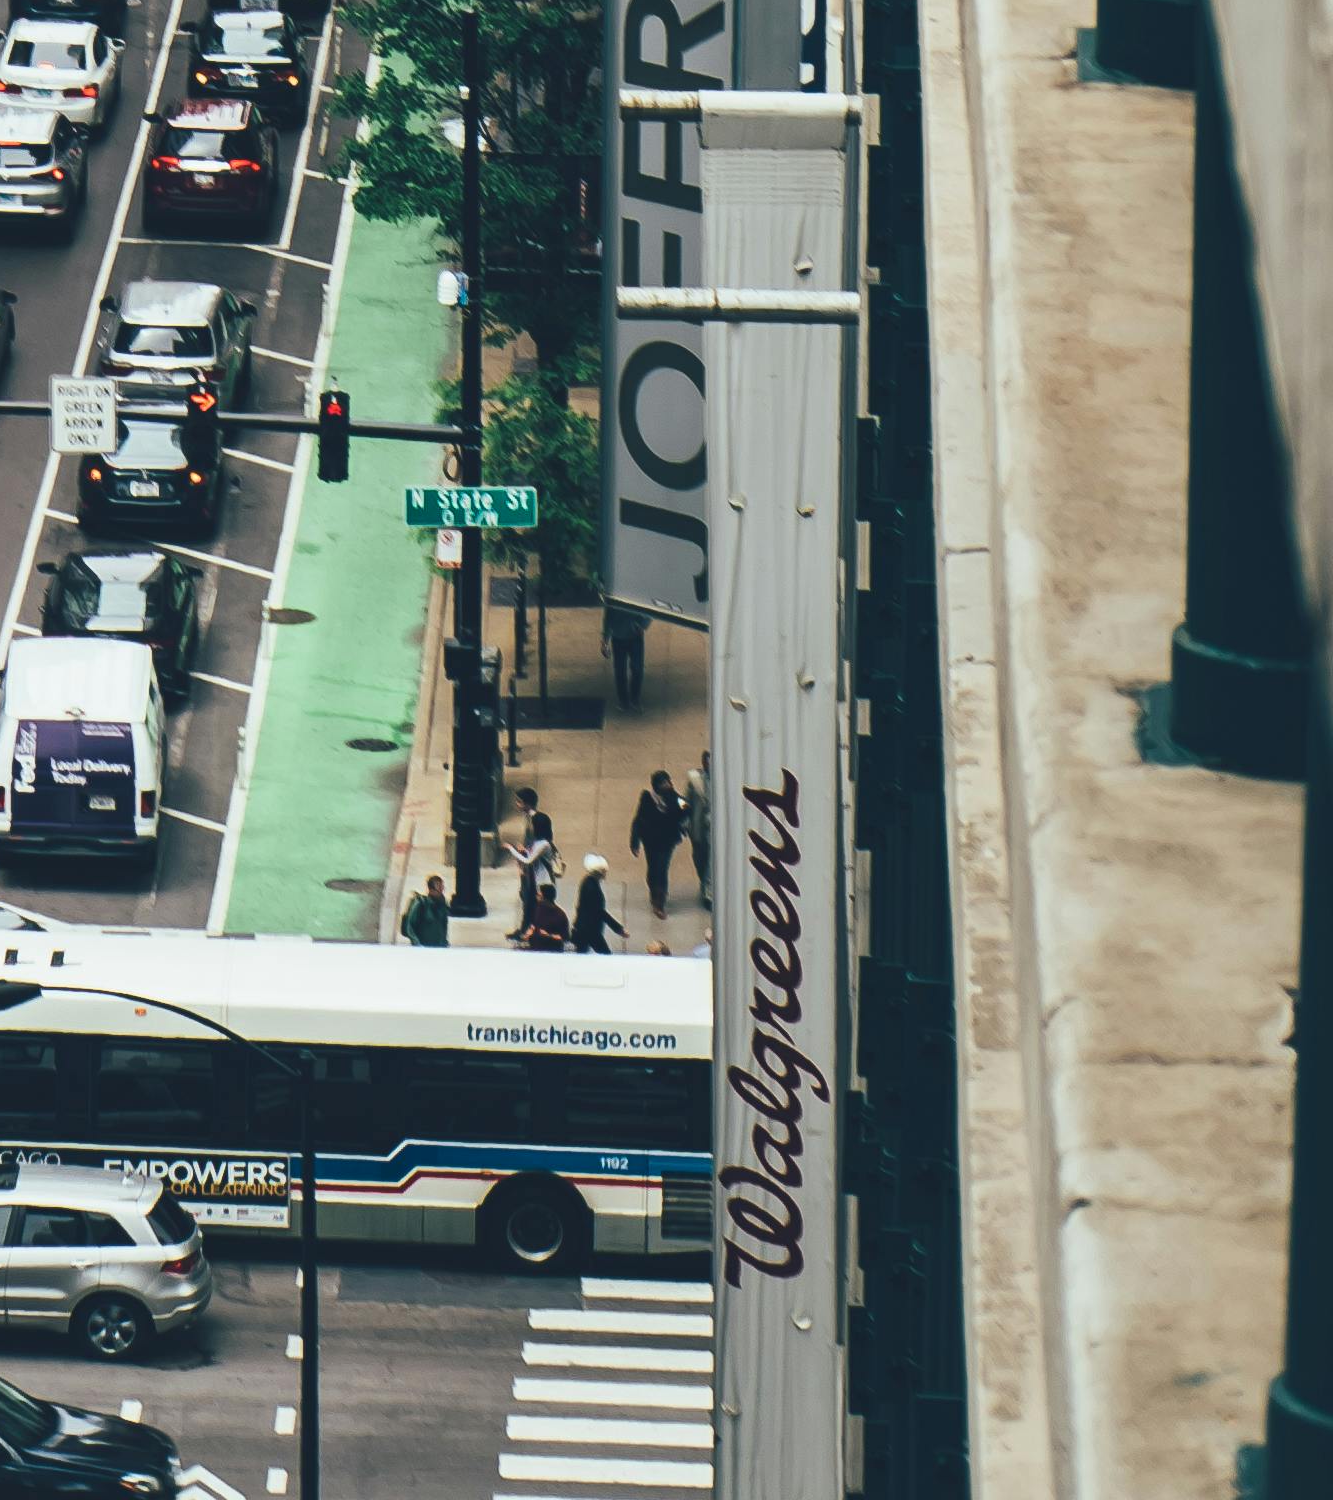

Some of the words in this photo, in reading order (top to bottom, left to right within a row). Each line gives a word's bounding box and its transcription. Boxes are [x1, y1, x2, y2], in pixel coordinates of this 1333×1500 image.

[411, 488, 425, 509] N
[438, 489, 494, 511] State
[506, 488, 529, 511] St
[467, 1022, 677, 1050] transitchicago.com
[723, 767, 831, 1290] Walgreens
[201, 1182, 286, 1197] LEARNING
